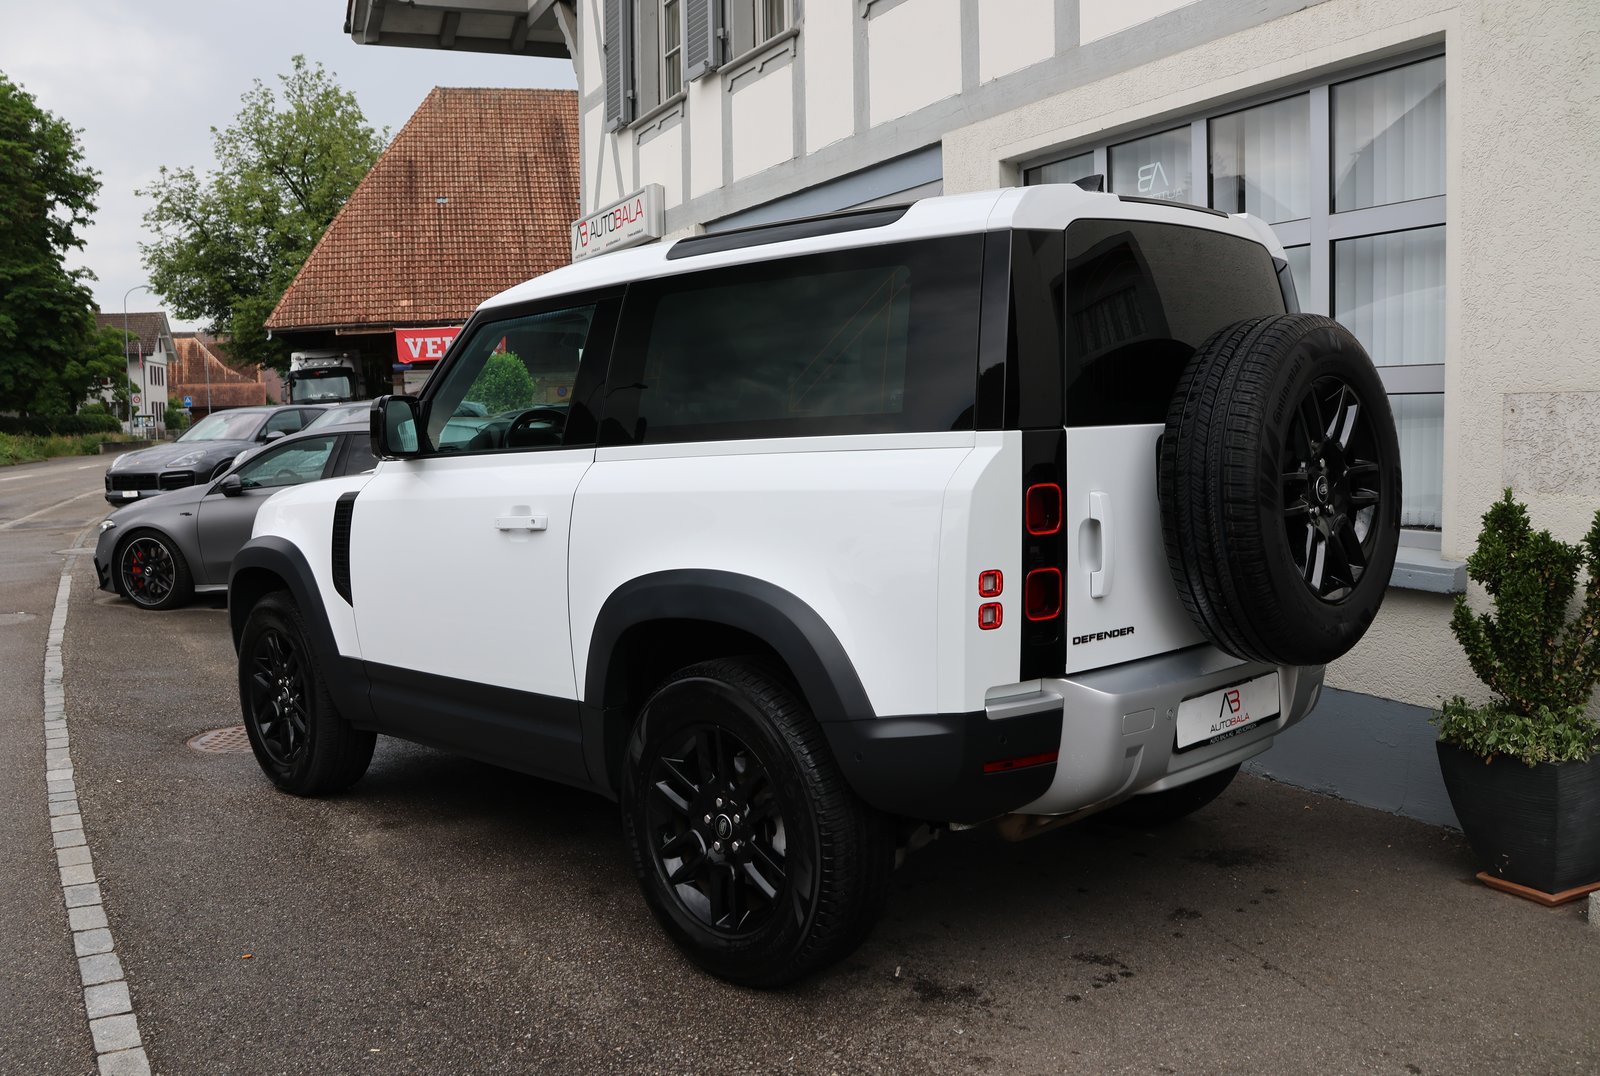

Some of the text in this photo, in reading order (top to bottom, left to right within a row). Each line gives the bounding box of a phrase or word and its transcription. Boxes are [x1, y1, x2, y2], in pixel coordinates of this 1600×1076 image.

[590, 199, 644, 240] AUTOBALA
[1072, 626, 1135, 646] DEFENDER
[1209, 712, 1250, 733] AUTOBALA
